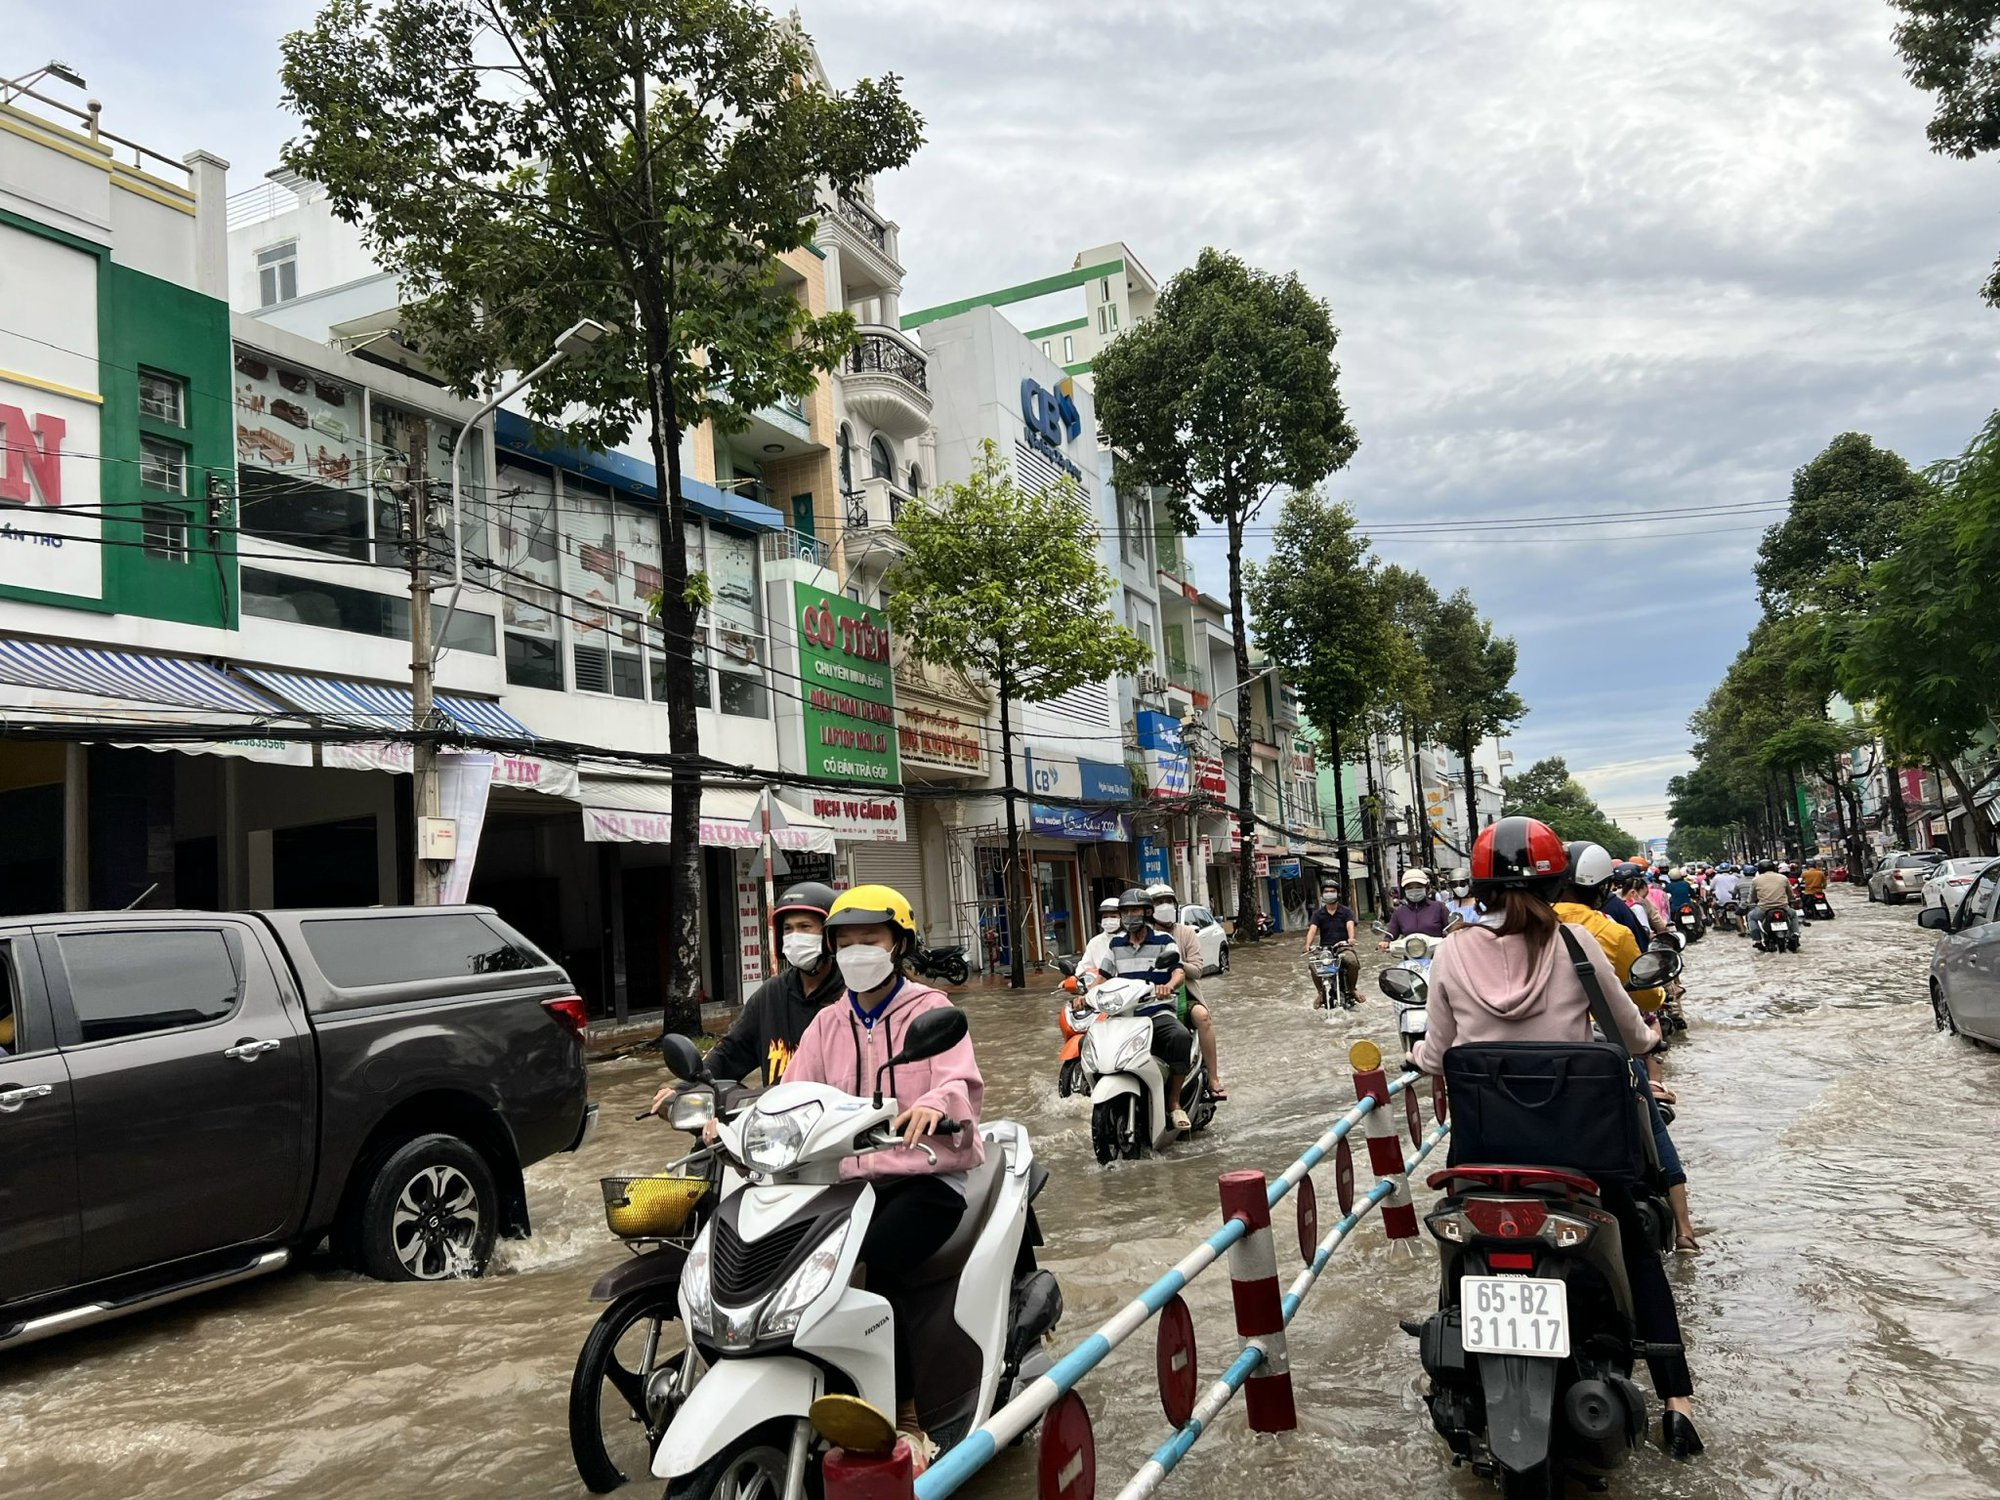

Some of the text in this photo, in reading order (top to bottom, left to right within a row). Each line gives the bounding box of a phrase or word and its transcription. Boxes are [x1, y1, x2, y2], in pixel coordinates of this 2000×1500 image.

[803, 598, 835, 650] CÔ
[820, 725, 854, 749] LAPTOP
[823, 756, 836, 773] CÓ
[837, 758, 855, 775] BÁN
[871, 764, 888, 779] GÓP
[1034, 770, 1050, 792] CB
[813, 799, 840, 819] DỊCH
[843, 801, 858, 821] VỤ
[631, 817, 671, 839] THẤ
[1477, 1283, 1549, 1315] 65-B2
[864, 1316, 890, 1336] HONDA
[1470, 1316, 1560, 1350] 311.17
